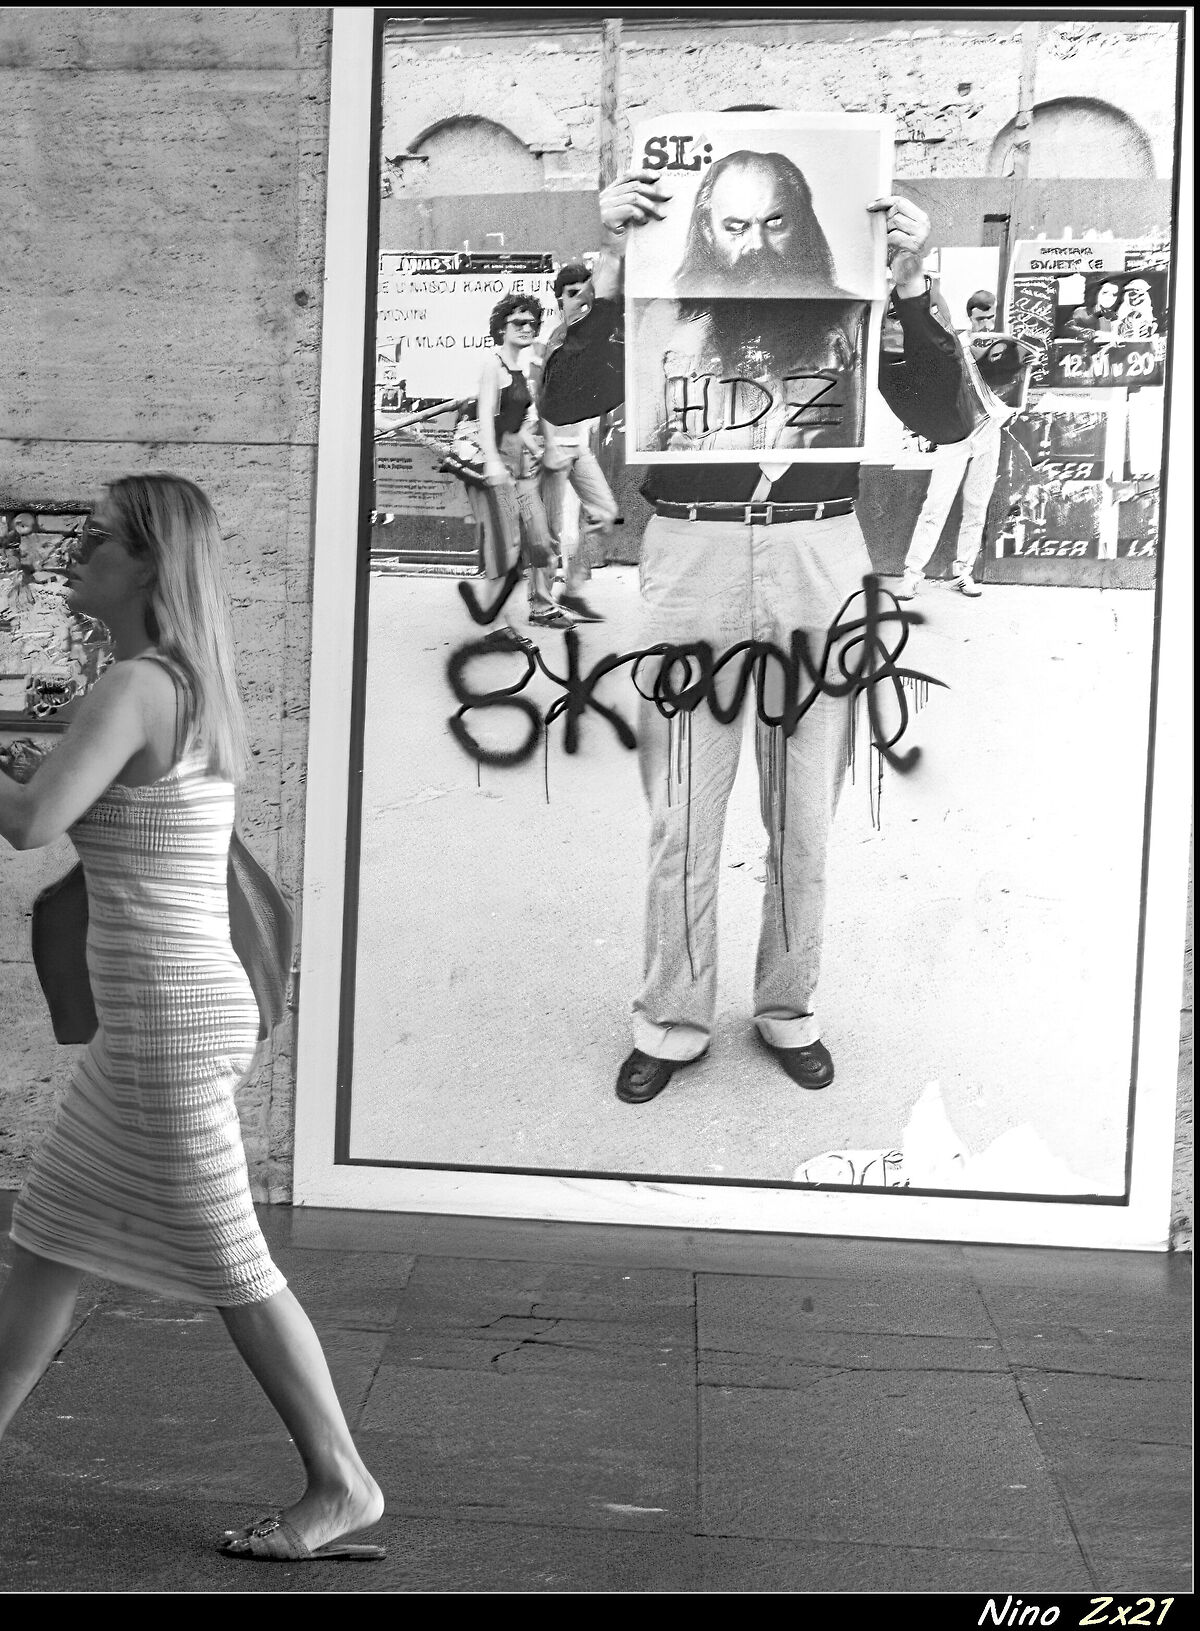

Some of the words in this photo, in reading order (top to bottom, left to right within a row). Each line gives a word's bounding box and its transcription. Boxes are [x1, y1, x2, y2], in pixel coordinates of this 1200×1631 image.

[642, 135, 713, 172] SL:
[463, 279, 504, 294] KAKO
[463, 335, 496, 349] LIJE
[672, 372, 845, 433] HDZ
